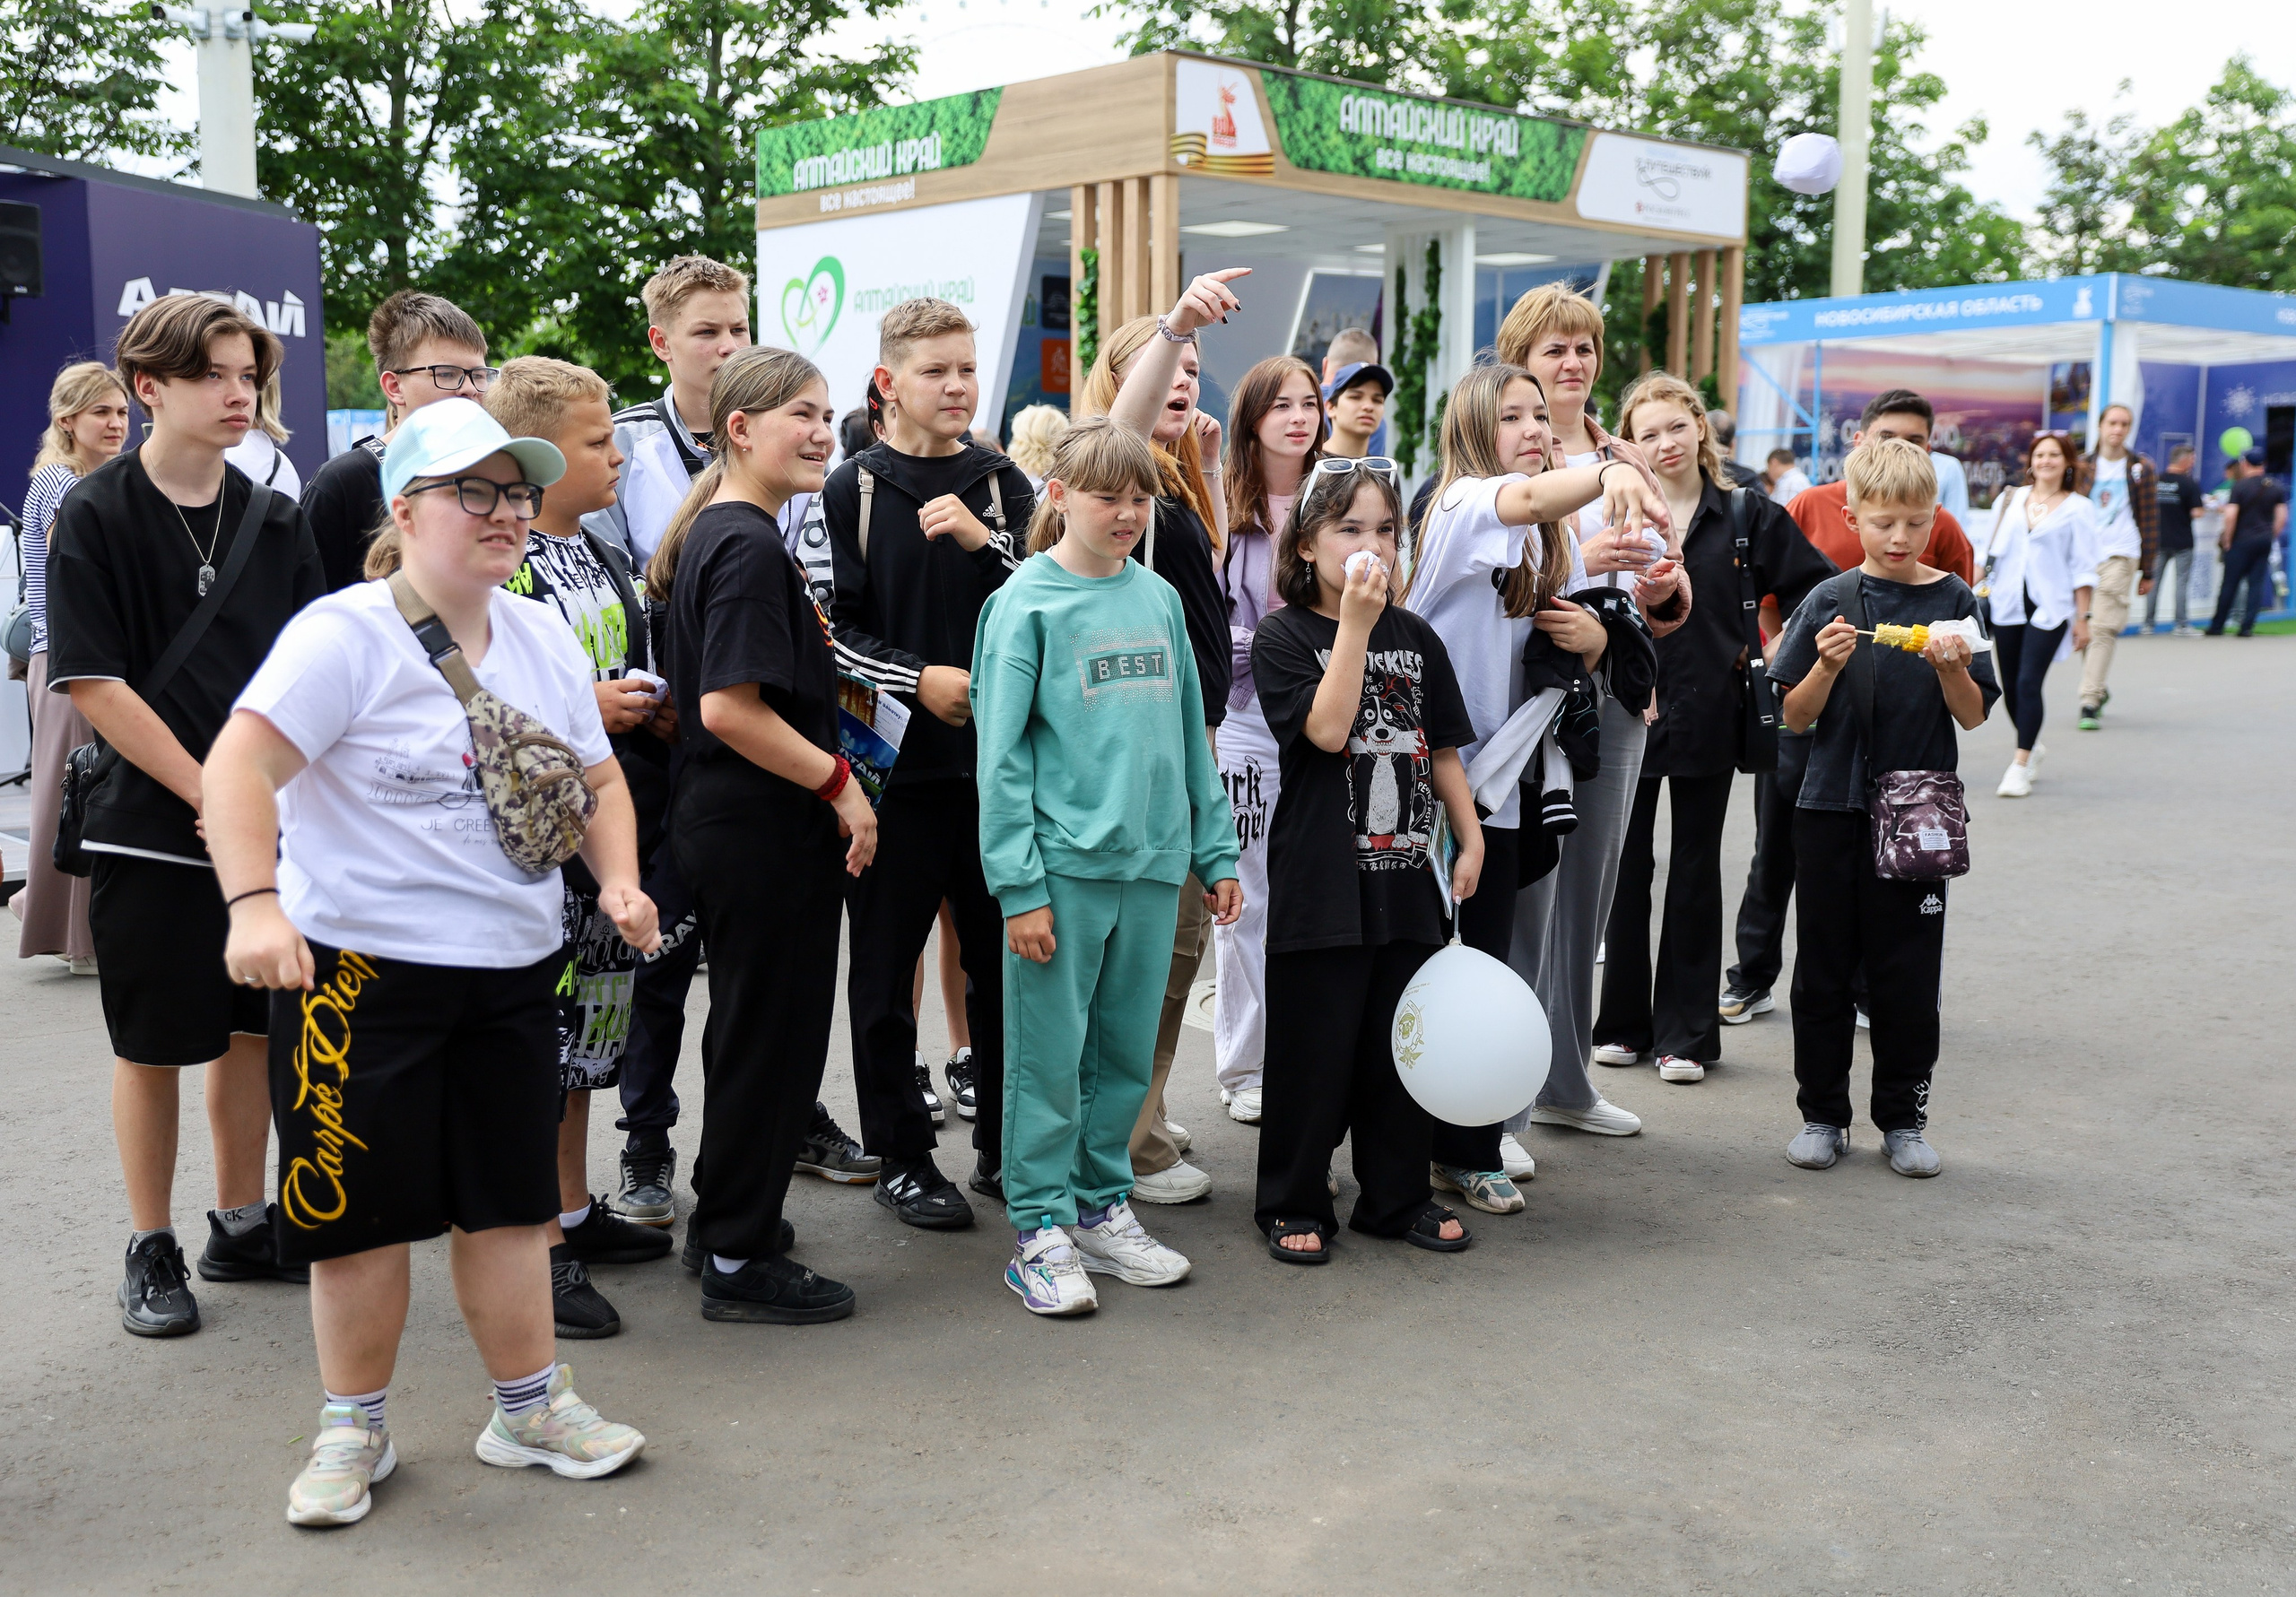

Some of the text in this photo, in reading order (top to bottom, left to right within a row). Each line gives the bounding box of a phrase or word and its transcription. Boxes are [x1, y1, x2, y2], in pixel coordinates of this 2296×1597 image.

[1340, 94, 1519, 157] АЛТАЙСКИЙ КРАЙ
[793, 130, 941, 191] АЛТАЙСКИЙ КРАЙ
[117, 276, 306, 338] ААЙ
[1814, 300, 1959, 328] НОВОСИБИРСКАЯ
[1960, 293, 2043, 317] ОБЛАСТЬ
[1097, 654, 1161, 680] BEST
[1920, 904, 1944, 916] Kappa
[283, 1081, 369, 1229] Carpe
